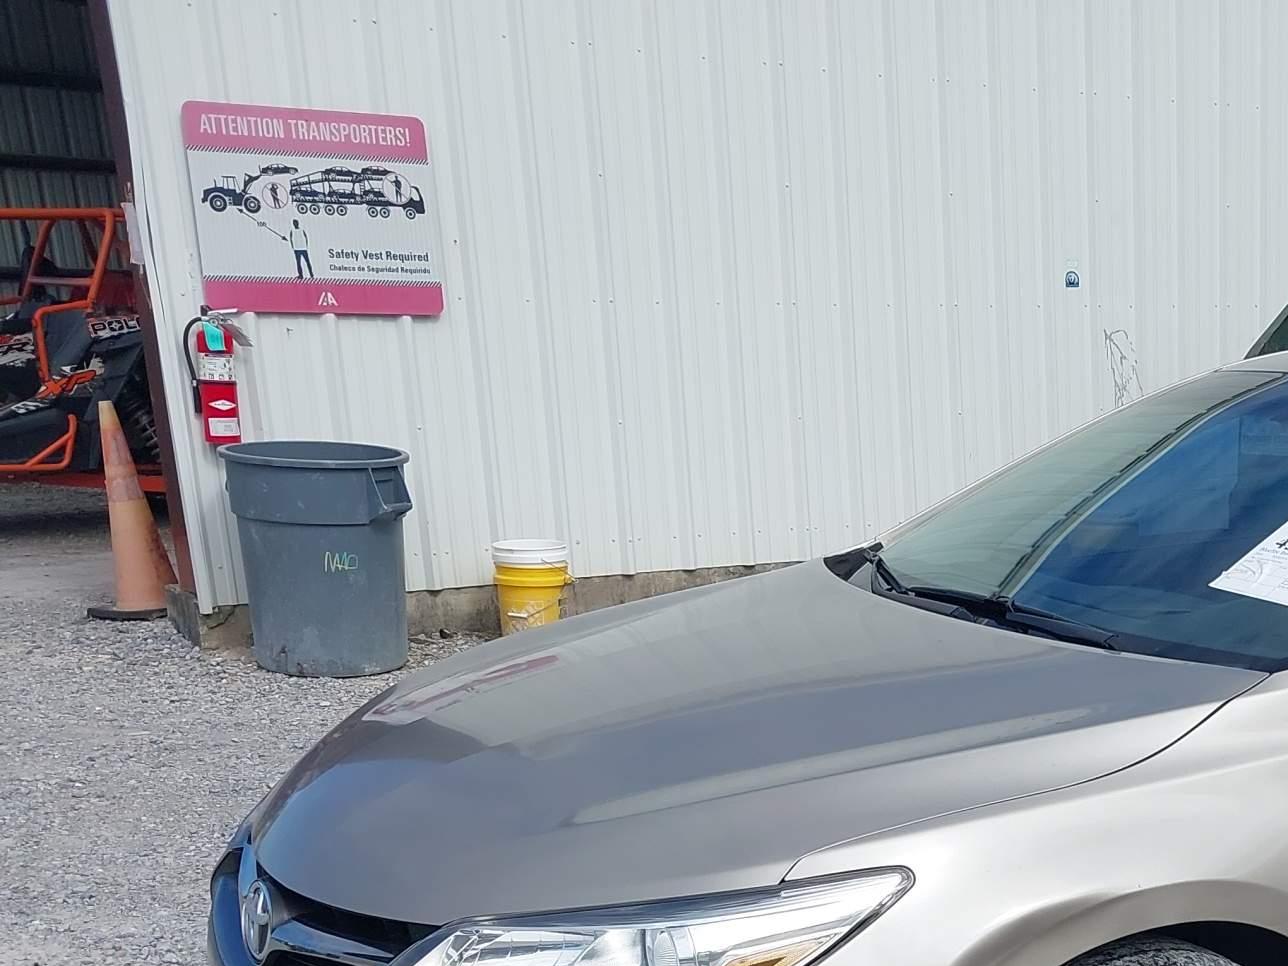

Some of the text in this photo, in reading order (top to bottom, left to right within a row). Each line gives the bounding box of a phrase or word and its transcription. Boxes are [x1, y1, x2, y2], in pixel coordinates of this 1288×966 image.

[200, 113, 412, 148] ATTENTION TRANSPORTERS!
[328, 248, 429, 263] Safety Vest Required
[90, 318, 141, 335] POL
